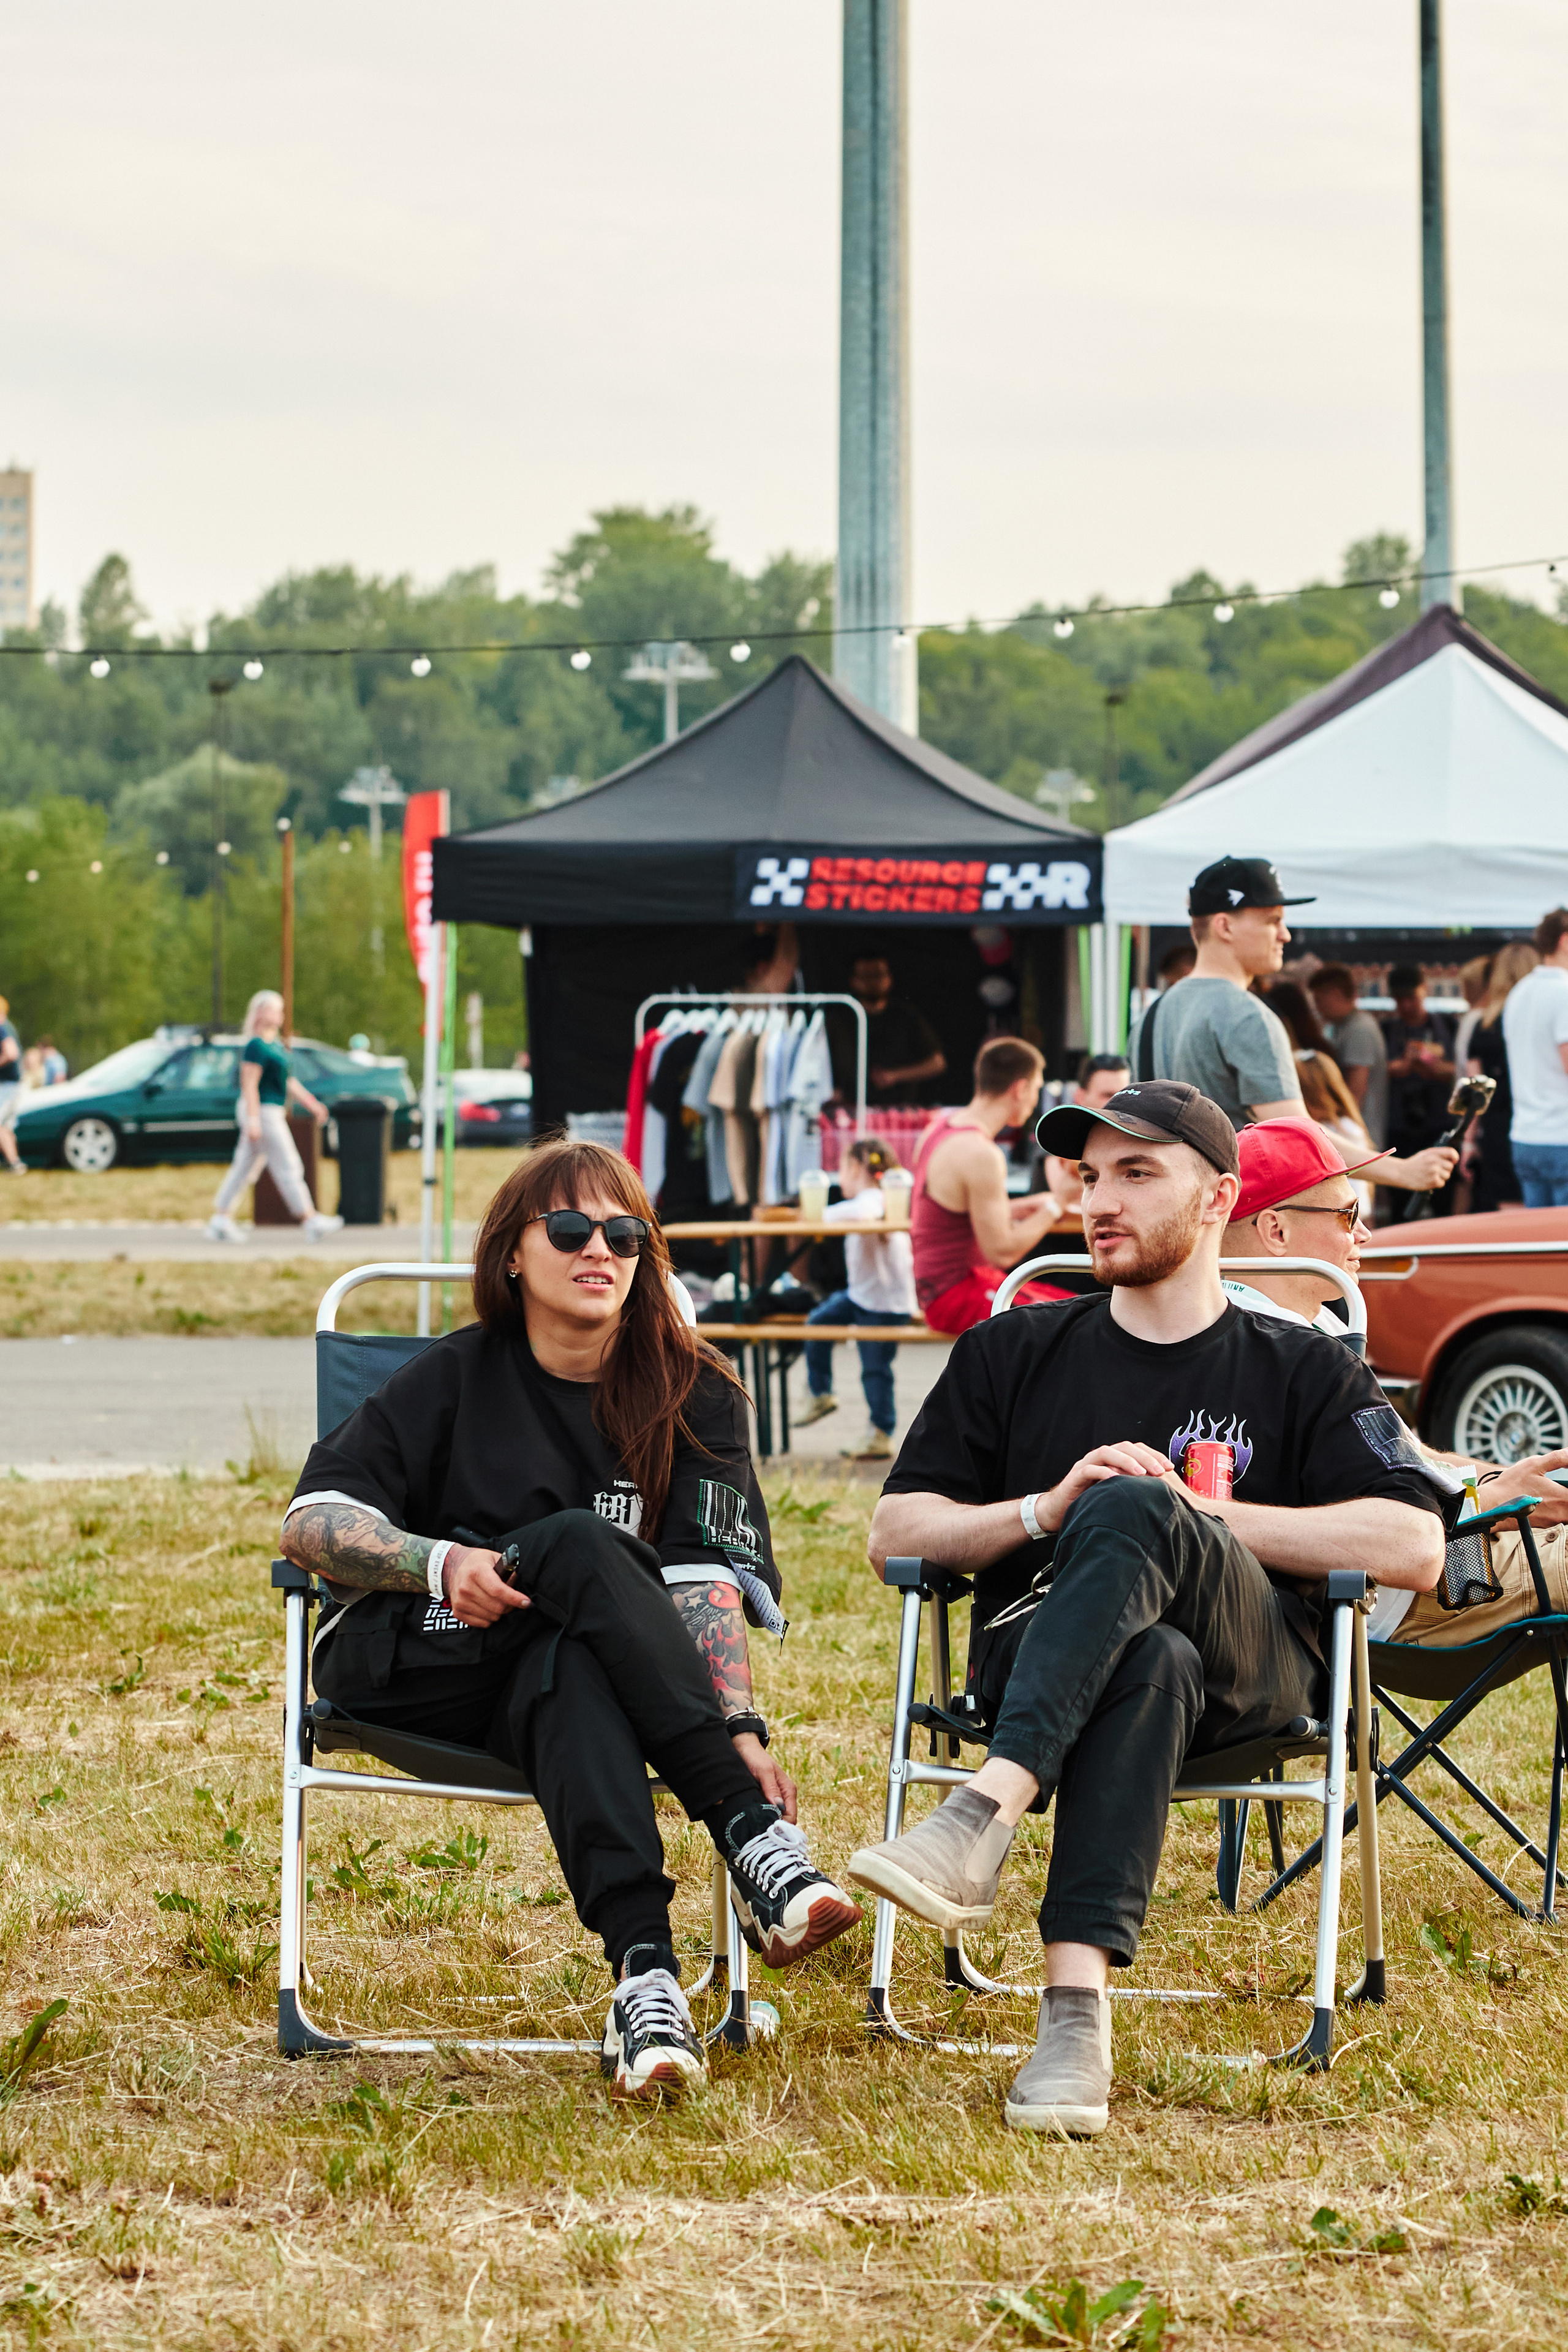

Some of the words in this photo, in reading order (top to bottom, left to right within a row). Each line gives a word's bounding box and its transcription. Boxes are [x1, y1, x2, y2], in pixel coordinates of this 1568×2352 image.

[810, 857, 988, 884] RESOURCE
[804, 883, 982, 914] STICKERS
[613, 1479, 638, 1489] HEA
